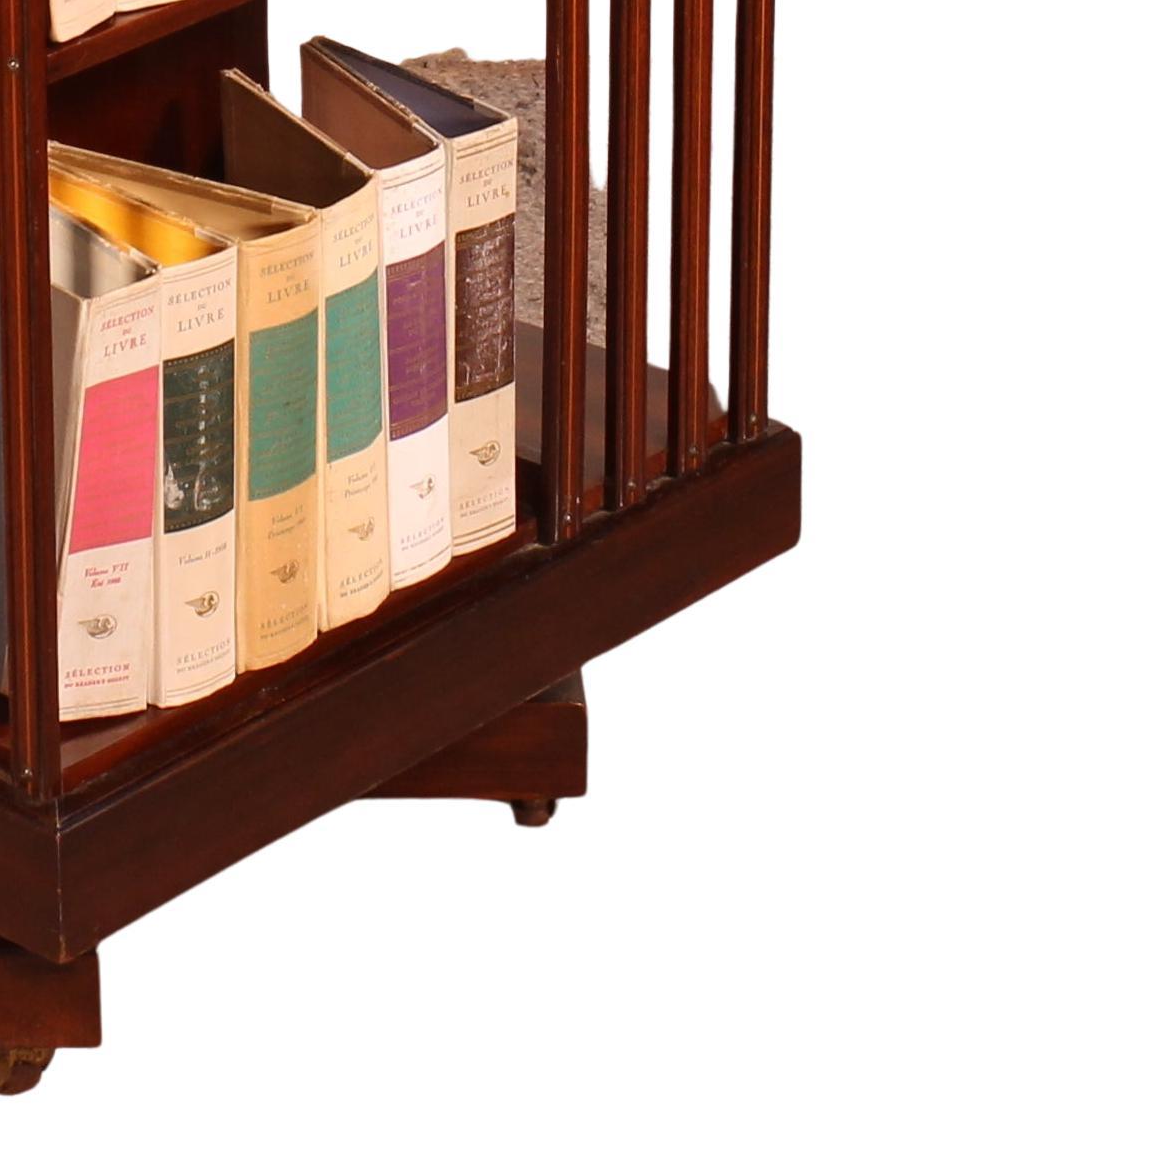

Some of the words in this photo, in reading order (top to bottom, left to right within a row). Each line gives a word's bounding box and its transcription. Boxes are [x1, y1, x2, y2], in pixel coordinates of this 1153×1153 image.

[459, 159, 514, 185] SÉLECTION
[467, 185, 507, 208] LIVRE
[168, 278, 231, 306] SÉLECTION
[100, 305, 155, 332] SÉLECTION
[177, 308, 225, 332] LIVRE
[103, 333, 148, 358] LIVRE
[64, 663, 130, 680] SÉLECTION
